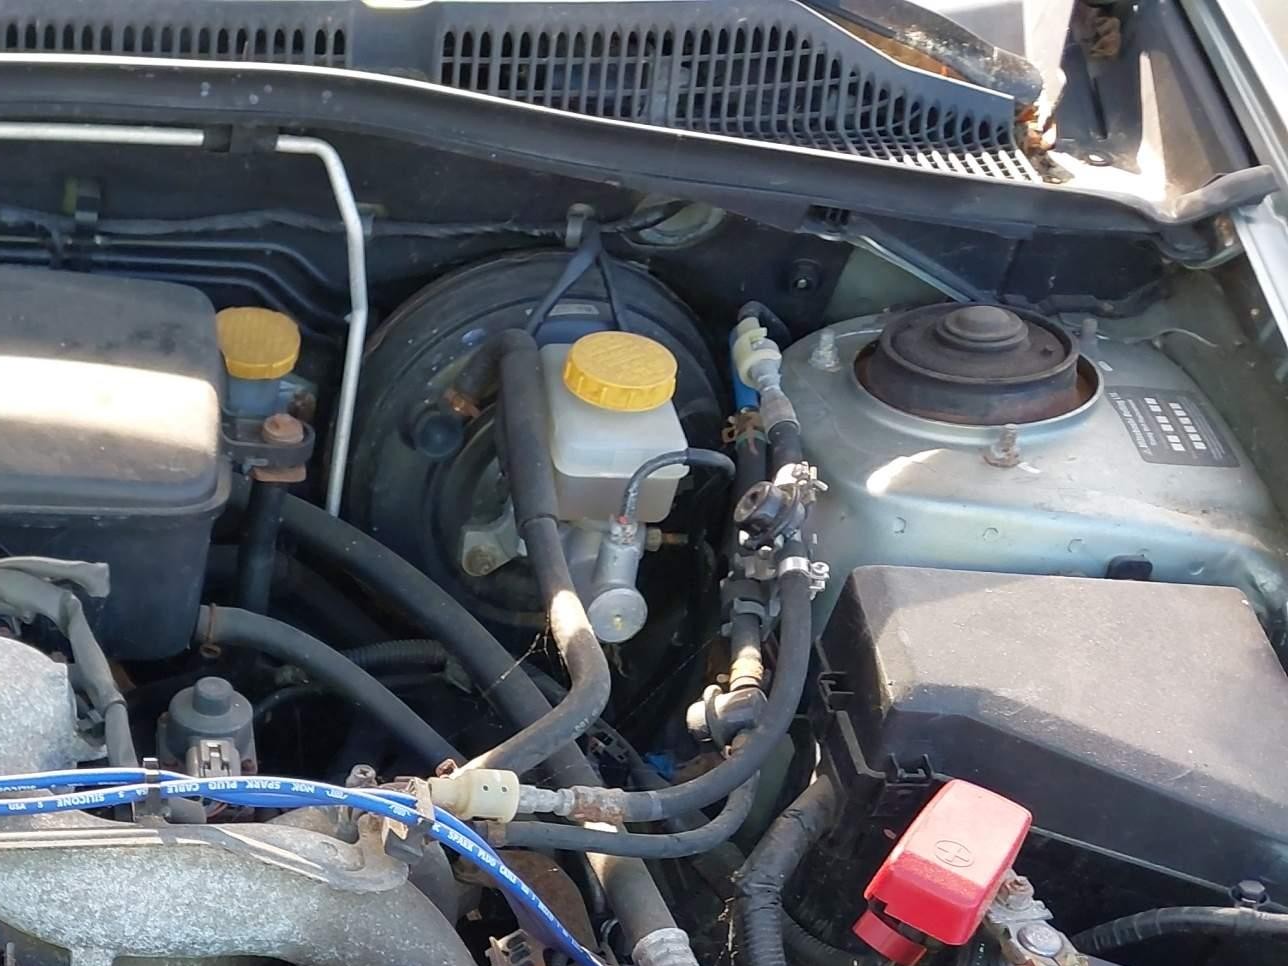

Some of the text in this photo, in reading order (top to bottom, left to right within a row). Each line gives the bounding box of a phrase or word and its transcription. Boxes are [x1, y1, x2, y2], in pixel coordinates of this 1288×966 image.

[166, 781, 200, 794] CABLE
[208, 780, 238, 791] PLUG
[245, 779, 282, 791] SPARK
[290, 781, 316, 794] NGK
[56, 792, 106, 809] SILICONE
[8, 803, 27, 811] USA
